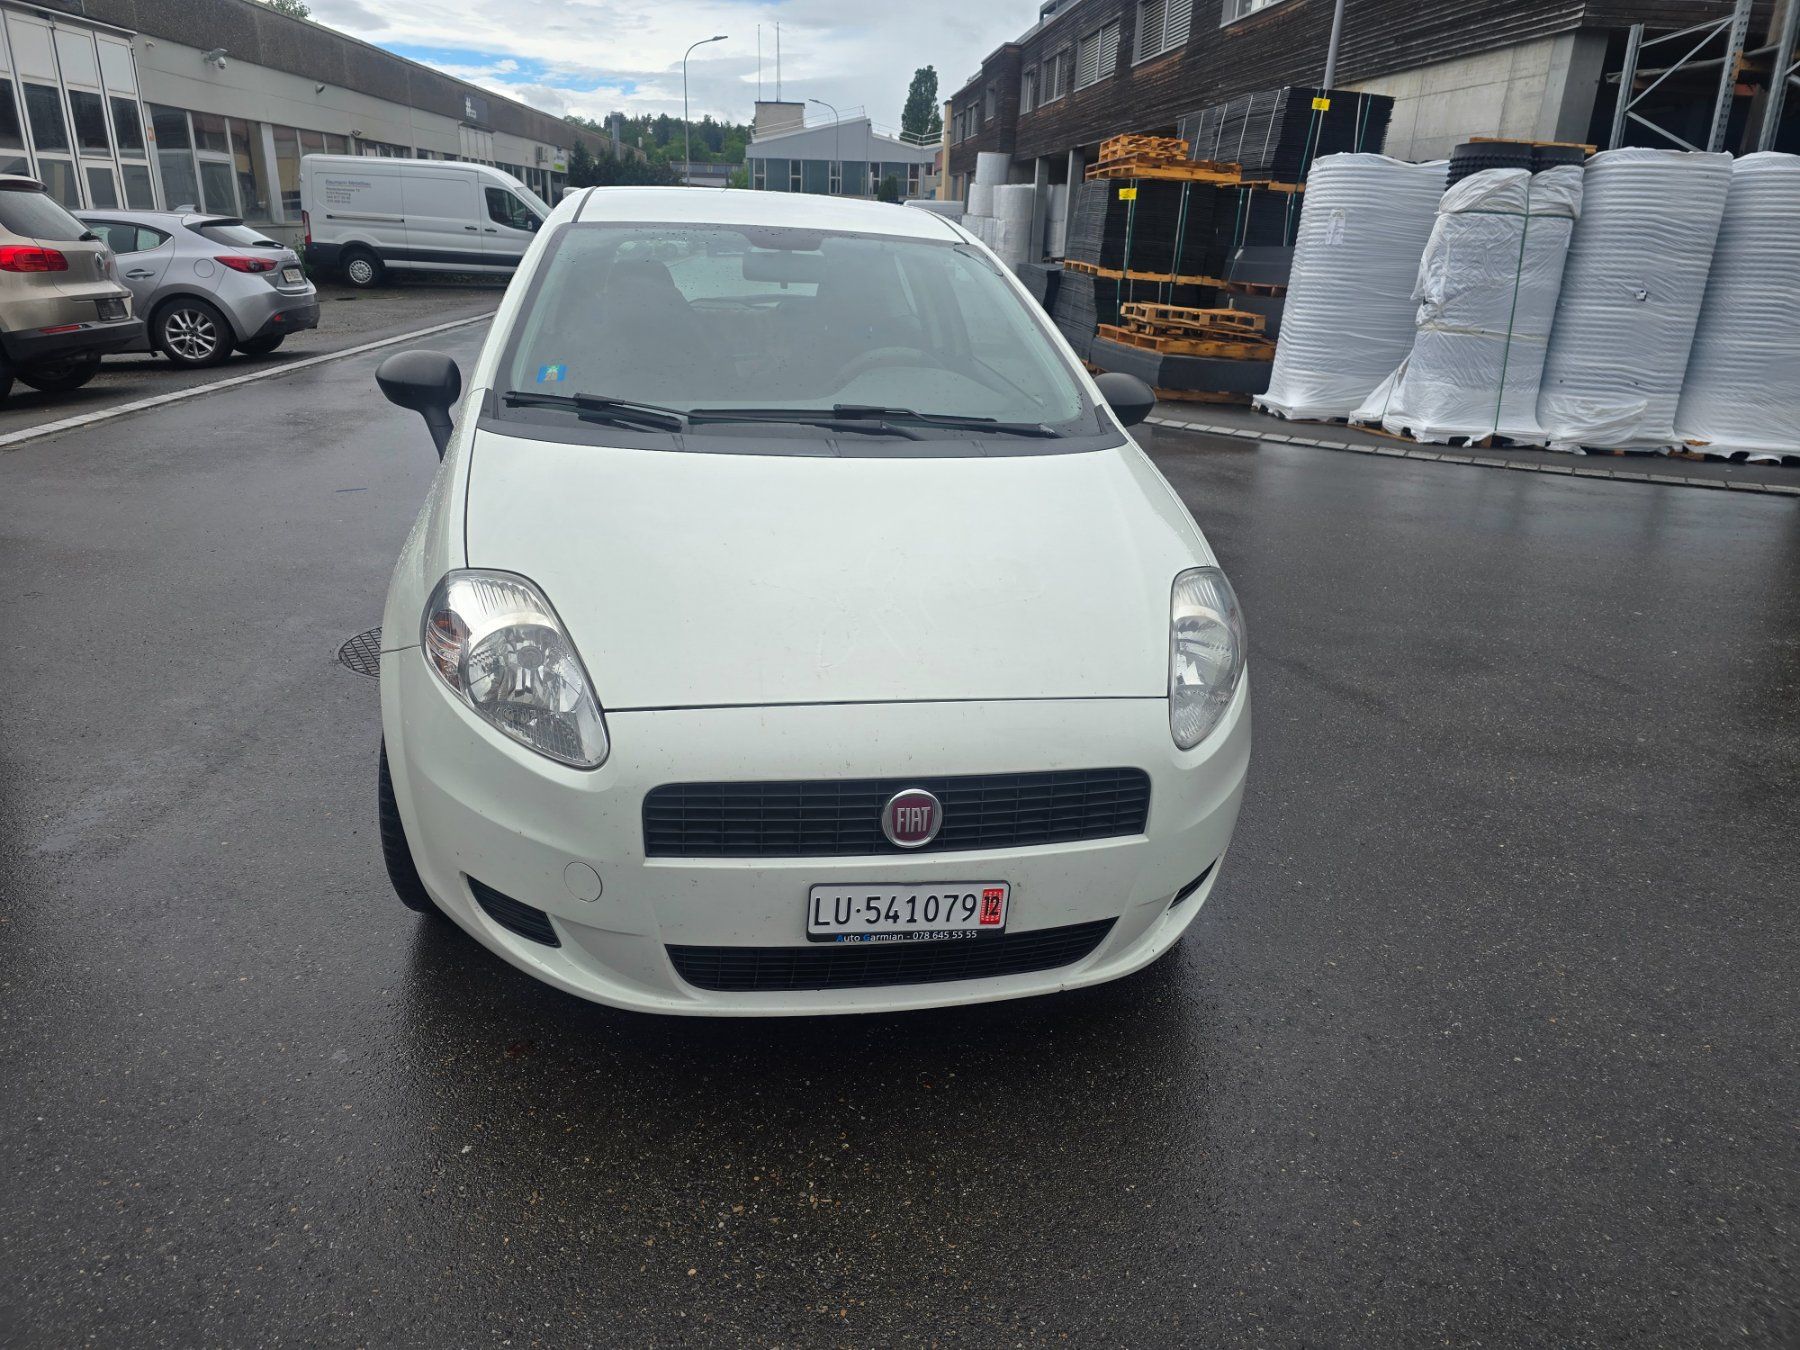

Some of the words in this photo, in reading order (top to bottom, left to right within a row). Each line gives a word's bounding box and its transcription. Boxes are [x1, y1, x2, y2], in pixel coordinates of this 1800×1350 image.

[897, 806, 931, 833] FIAT
[985, 895, 1000, 916] 12
[836, 933, 861, 942] Auto
[912, 931, 930, 940] 078
[932, 931, 950, 940] 645
[951, 930, 963, 939] 55
[965, 930, 977, 939] 55
